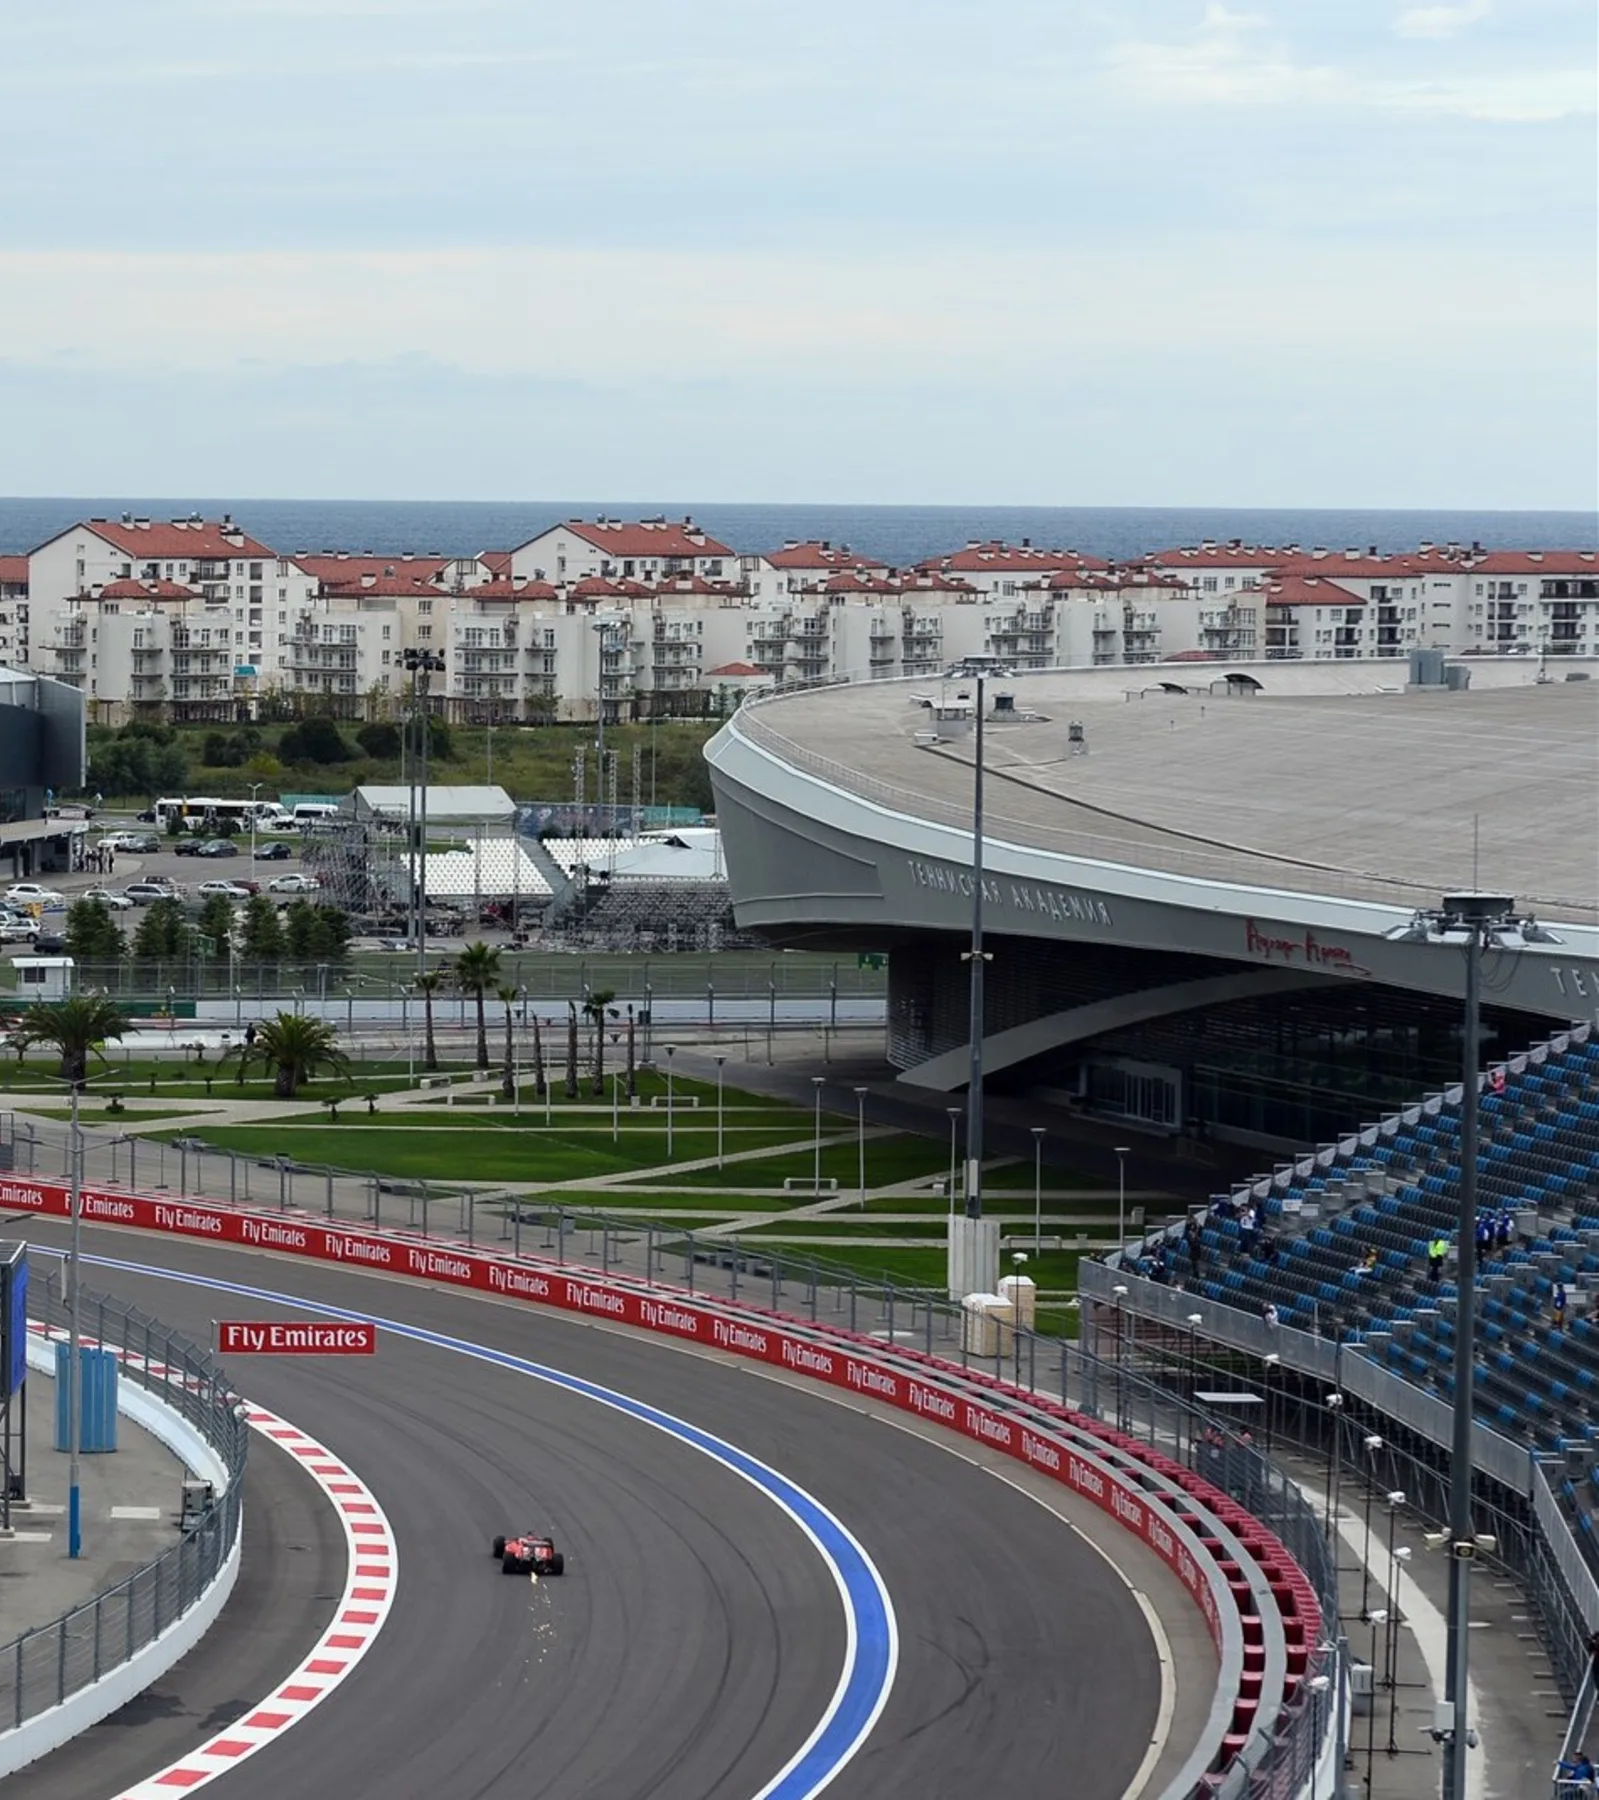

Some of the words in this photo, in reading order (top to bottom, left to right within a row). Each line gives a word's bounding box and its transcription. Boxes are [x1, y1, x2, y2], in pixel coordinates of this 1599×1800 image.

[1012, 885, 1113, 926] АКАДЕМИЯ
[1550, 966, 1599, 997] ТЕ
[65, 1194, 84, 1215] Fy
[86, 1195, 134, 1218] Emirates
[155, 1205, 175, 1228] Fly
[176, 1209, 222, 1233] Emirates
[242, 1220, 260, 1243] Fly
[261, 1223, 305, 1247] Emirates
[325, 1234, 343, 1257] Fly
[345, 1239, 390, 1263] Emirates
[409, 1250, 426, 1274] Fly
[428, 1255, 471, 1279] Emirates
[489, 1266, 506, 1290] Fly
[507, 1270, 549, 1296] Emirates
[566, 1283, 582, 1308] Fly
[583, 1287, 625, 1314] Emirates
[640, 1302, 657, 1327] Fly
[658, 1307, 697, 1333] Emirates
[228, 1326, 265, 1350] Fly
[270, 1326, 367, 1347] Emirates
[714, 1320, 730, 1346] Fly
[730, 1326, 767, 1353] Emirates
[782, 1340, 797, 1366] Fly
[797, 1345, 833, 1374] Emirates
[847, 1361, 862, 1388] Fly
[862, 1366, 896, 1396] Emirates
[909, 1382, 923, 1411] Fly
[923, 1388, 955, 1420] Emirates
[967, 1407, 980, 1436] Fly
[980, 1412, 1011, 1445] Emirates
[1022, 1432, 1033, 1461] Fly
[1032, 1438, 1060, 1471] Emirates
